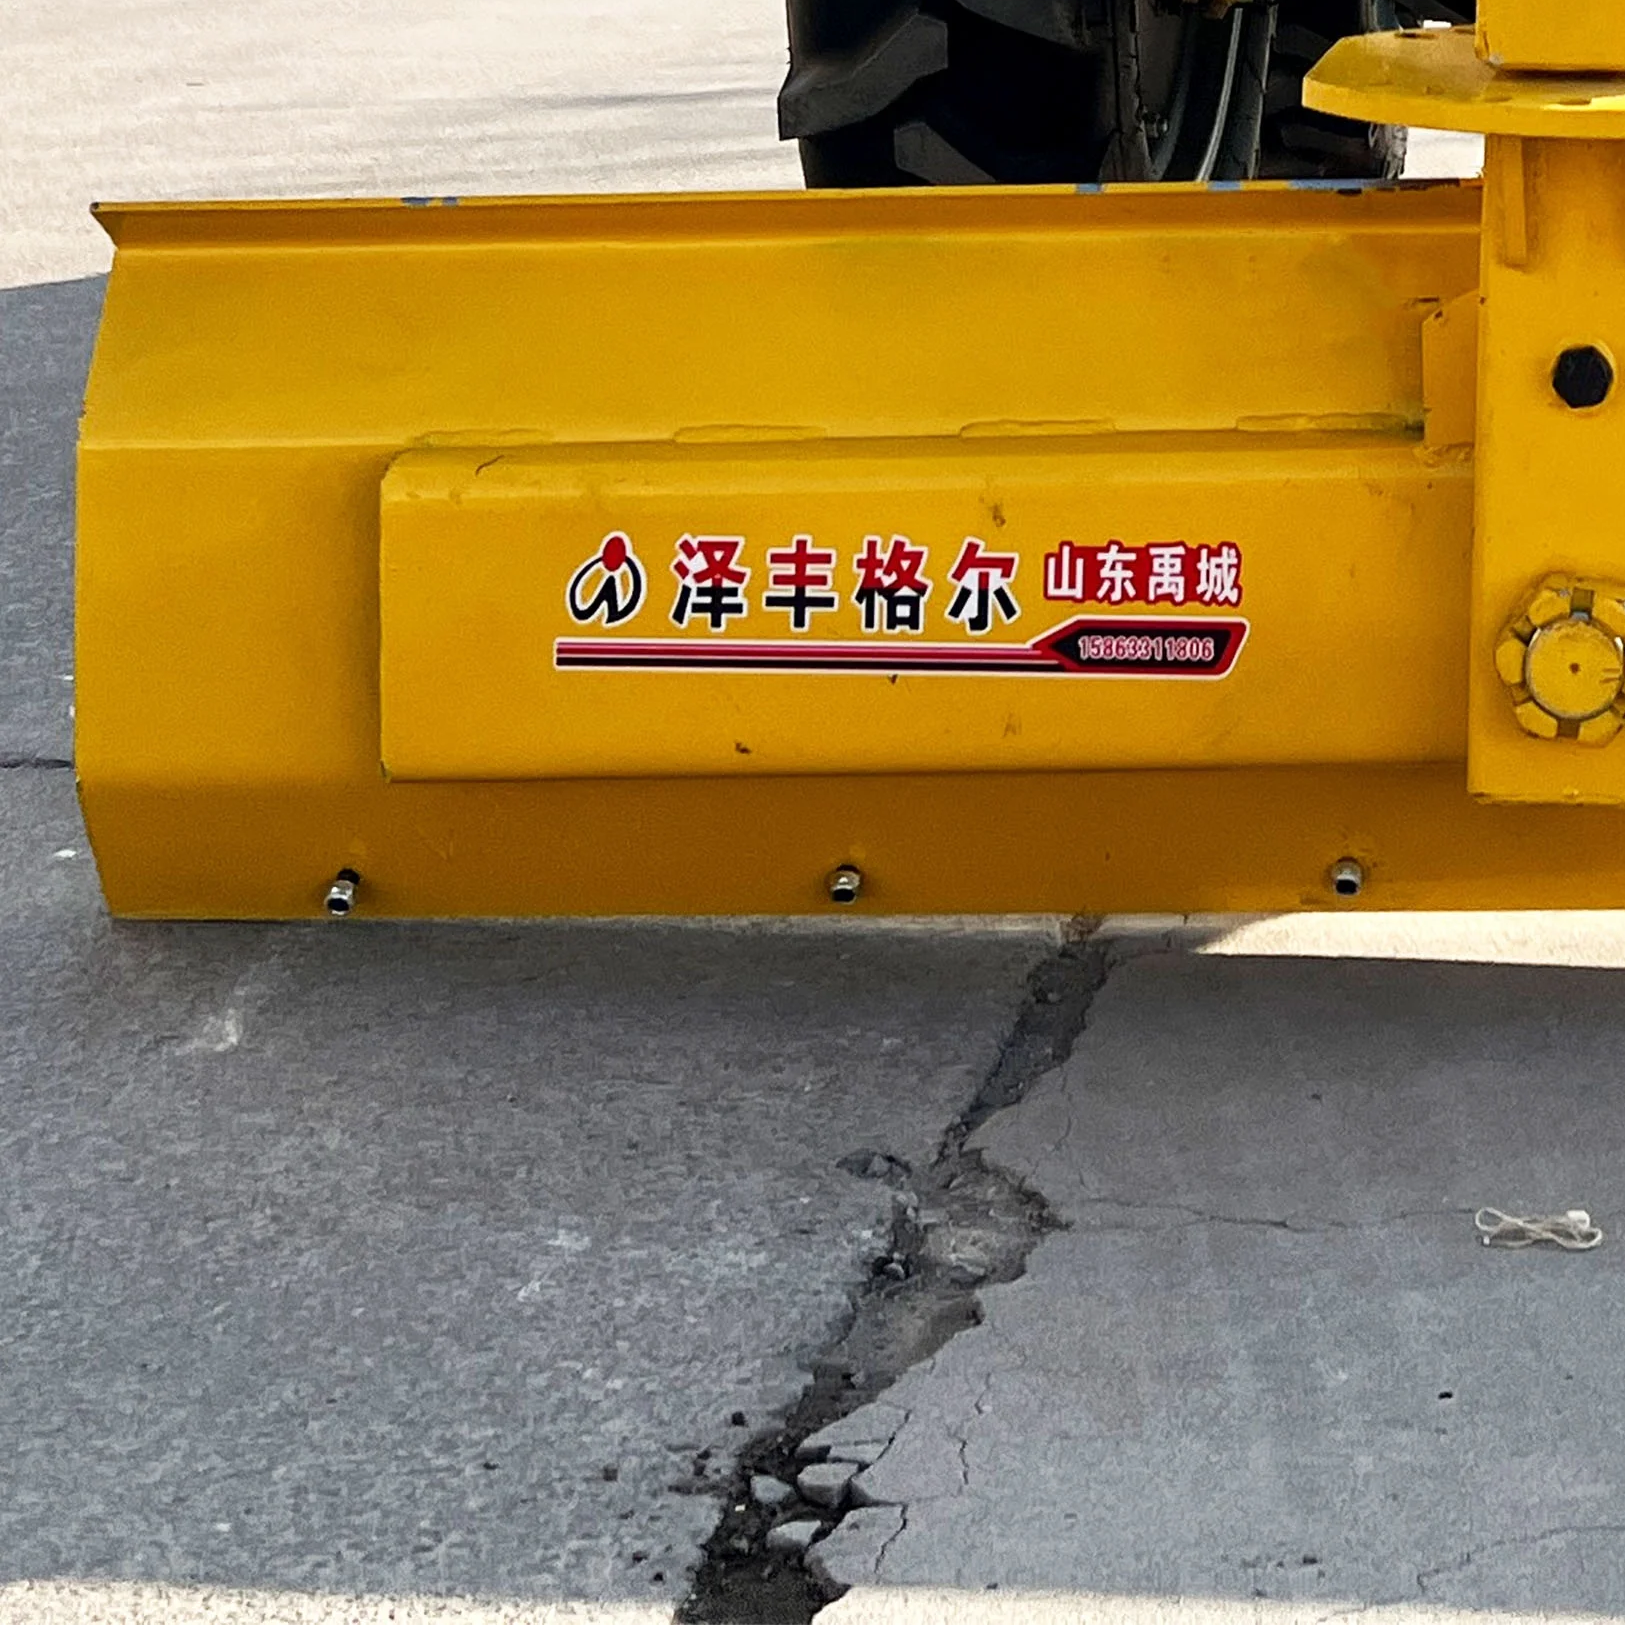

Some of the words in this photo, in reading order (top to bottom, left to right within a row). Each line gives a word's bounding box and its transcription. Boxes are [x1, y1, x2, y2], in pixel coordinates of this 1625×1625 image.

[671, 536, 1019, 632] 泽丰格尔
[1046, 543, 1241, 605] 山东禹城
[1078, 635, 1215, 661] 15863311806
